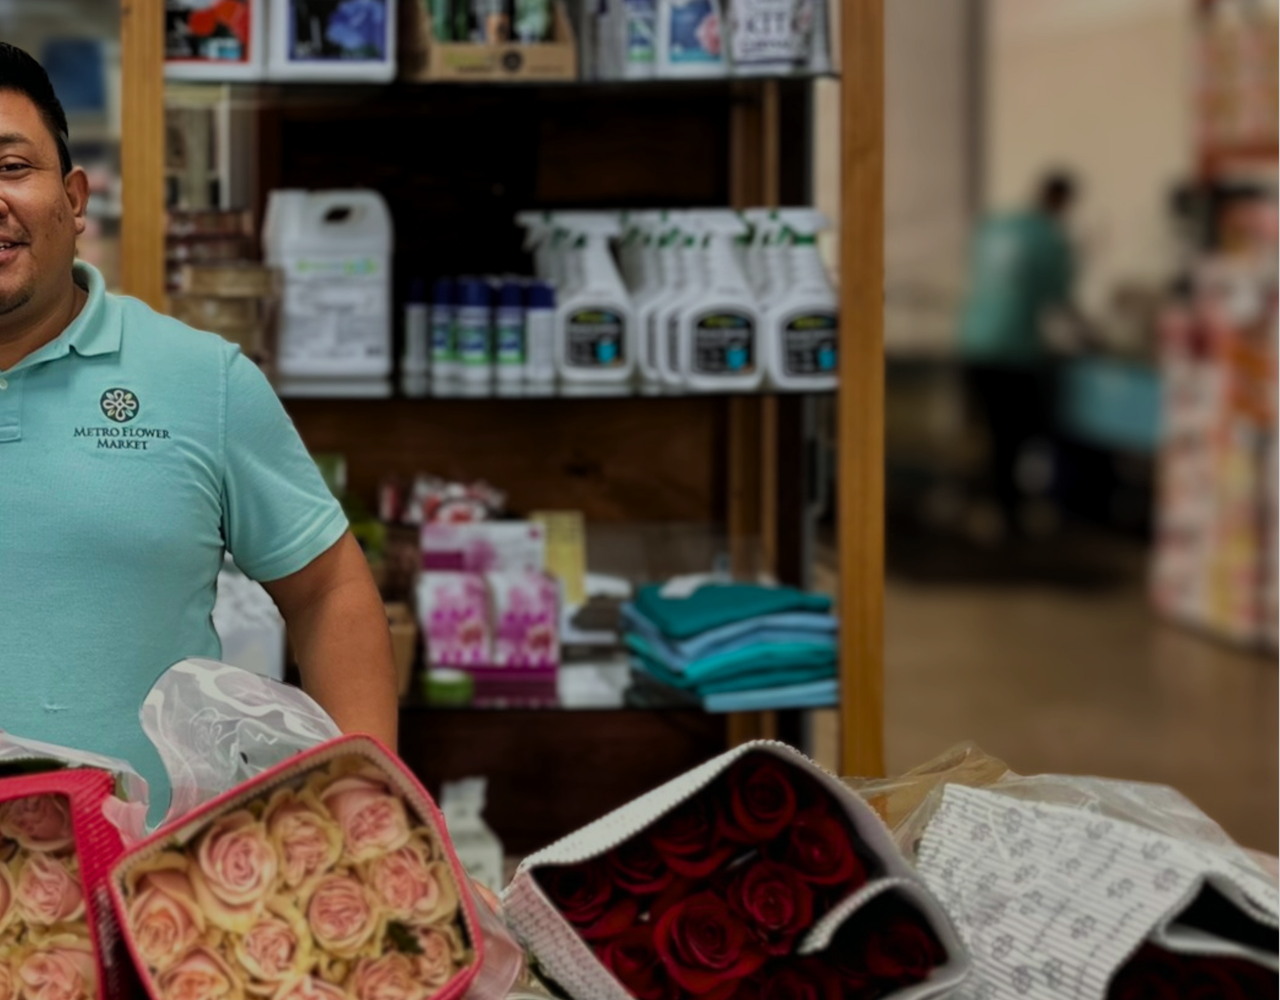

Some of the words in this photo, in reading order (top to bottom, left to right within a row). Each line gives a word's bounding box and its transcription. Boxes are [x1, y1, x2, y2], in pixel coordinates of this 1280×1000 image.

[73, 427, 120, 438] METRO
[122, 427, 171, 439] FLOWER
[96, 439, 149, 450] MARKET
